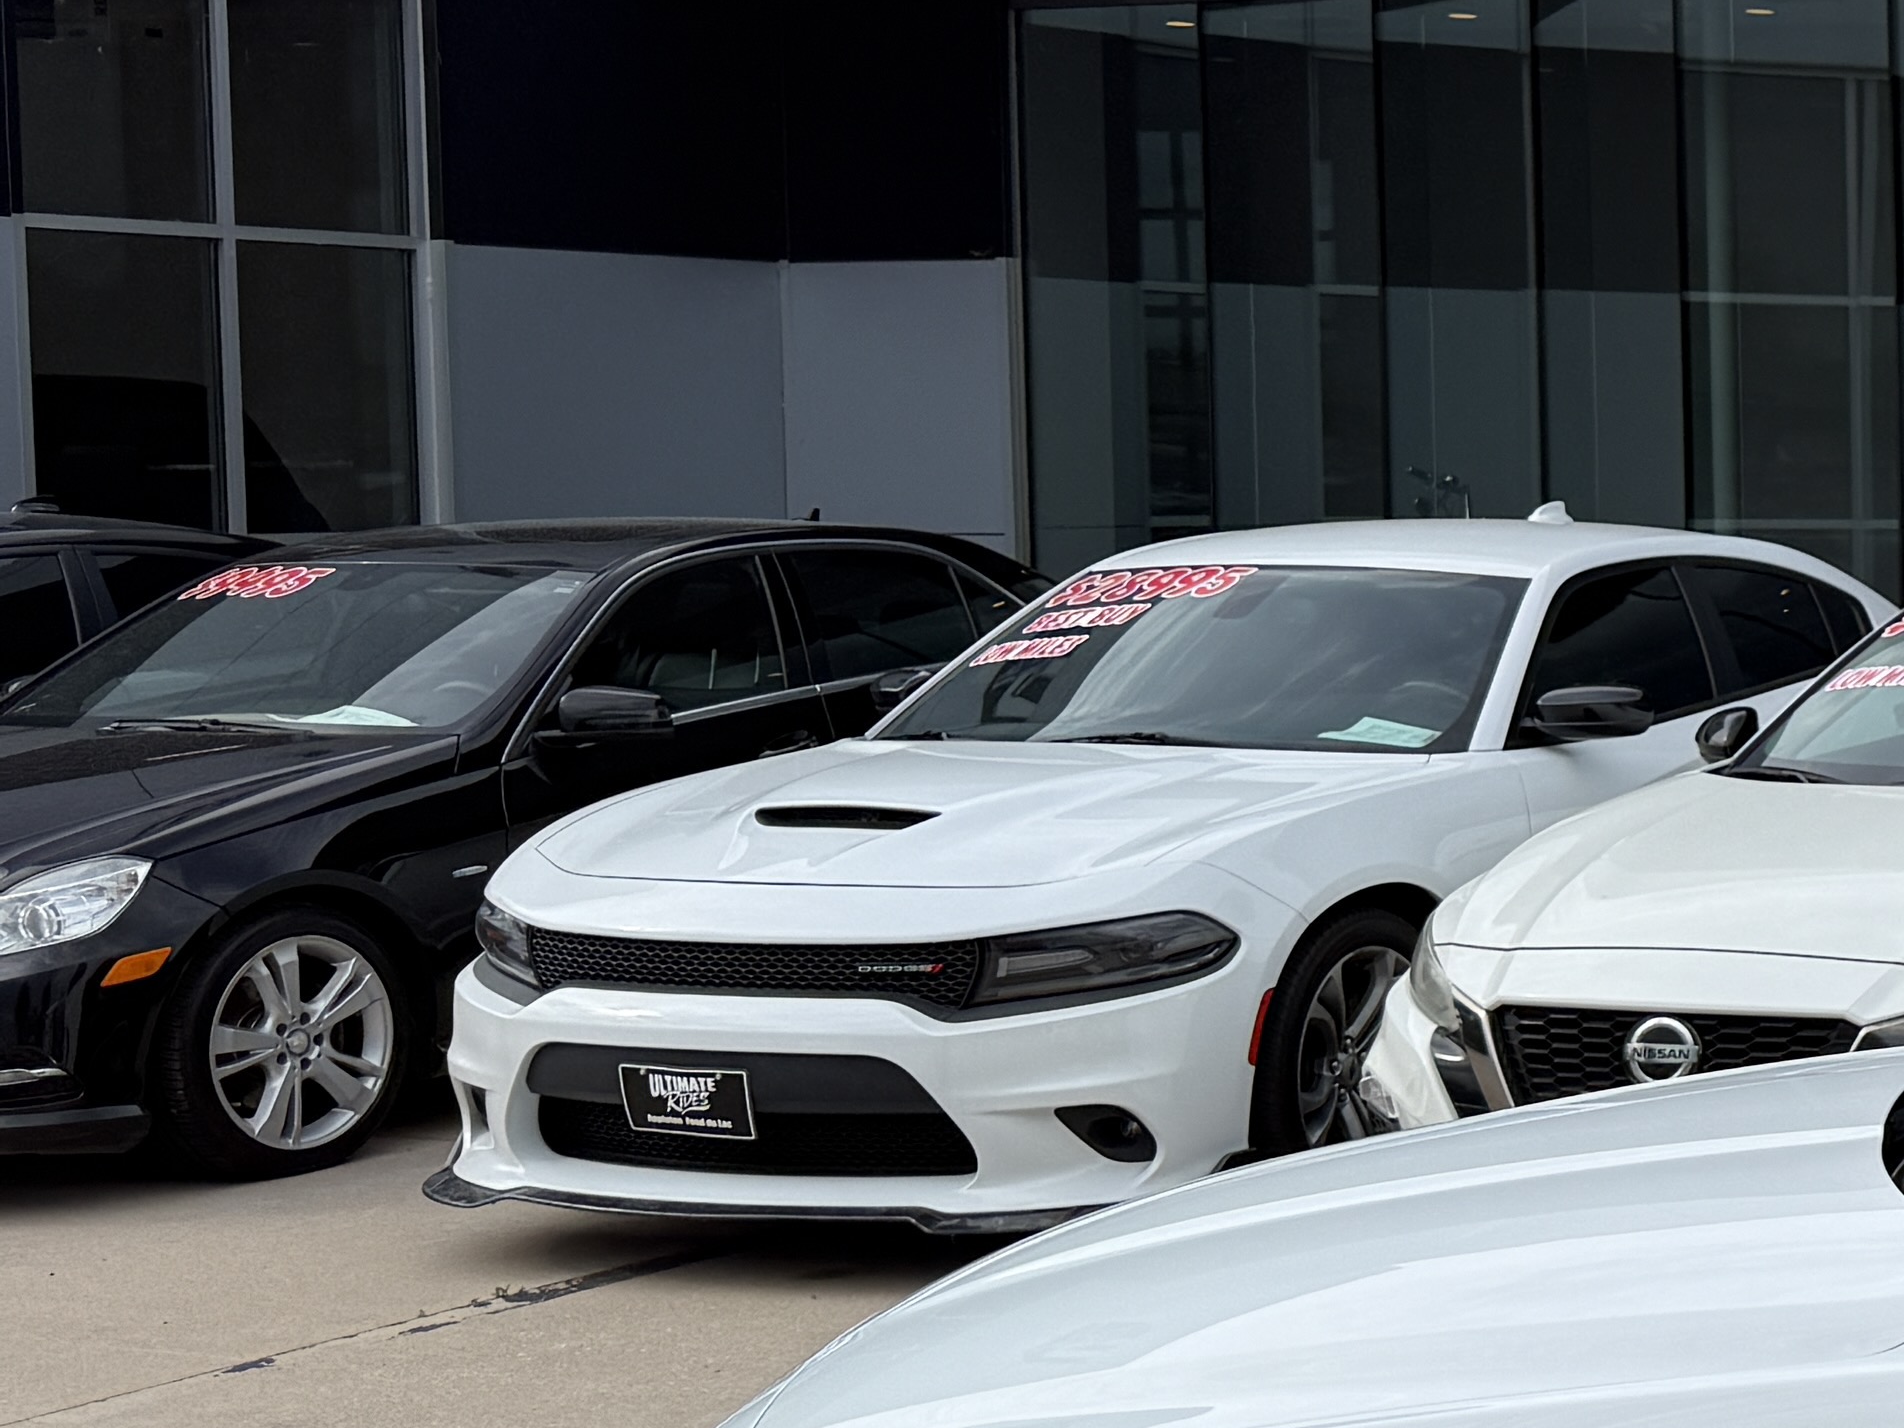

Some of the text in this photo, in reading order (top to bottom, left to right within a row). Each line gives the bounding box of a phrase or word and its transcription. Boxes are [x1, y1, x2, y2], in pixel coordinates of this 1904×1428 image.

[1045, 566, 1259, 608] $28995
[1022, 603, 1152, 634] BEST BUY
[1012, 634, 1090, 660] MILES
[1632, 1046, 1690, 1060] NISSAN
[648, 1073, 717, 1098] ULTIMATE
